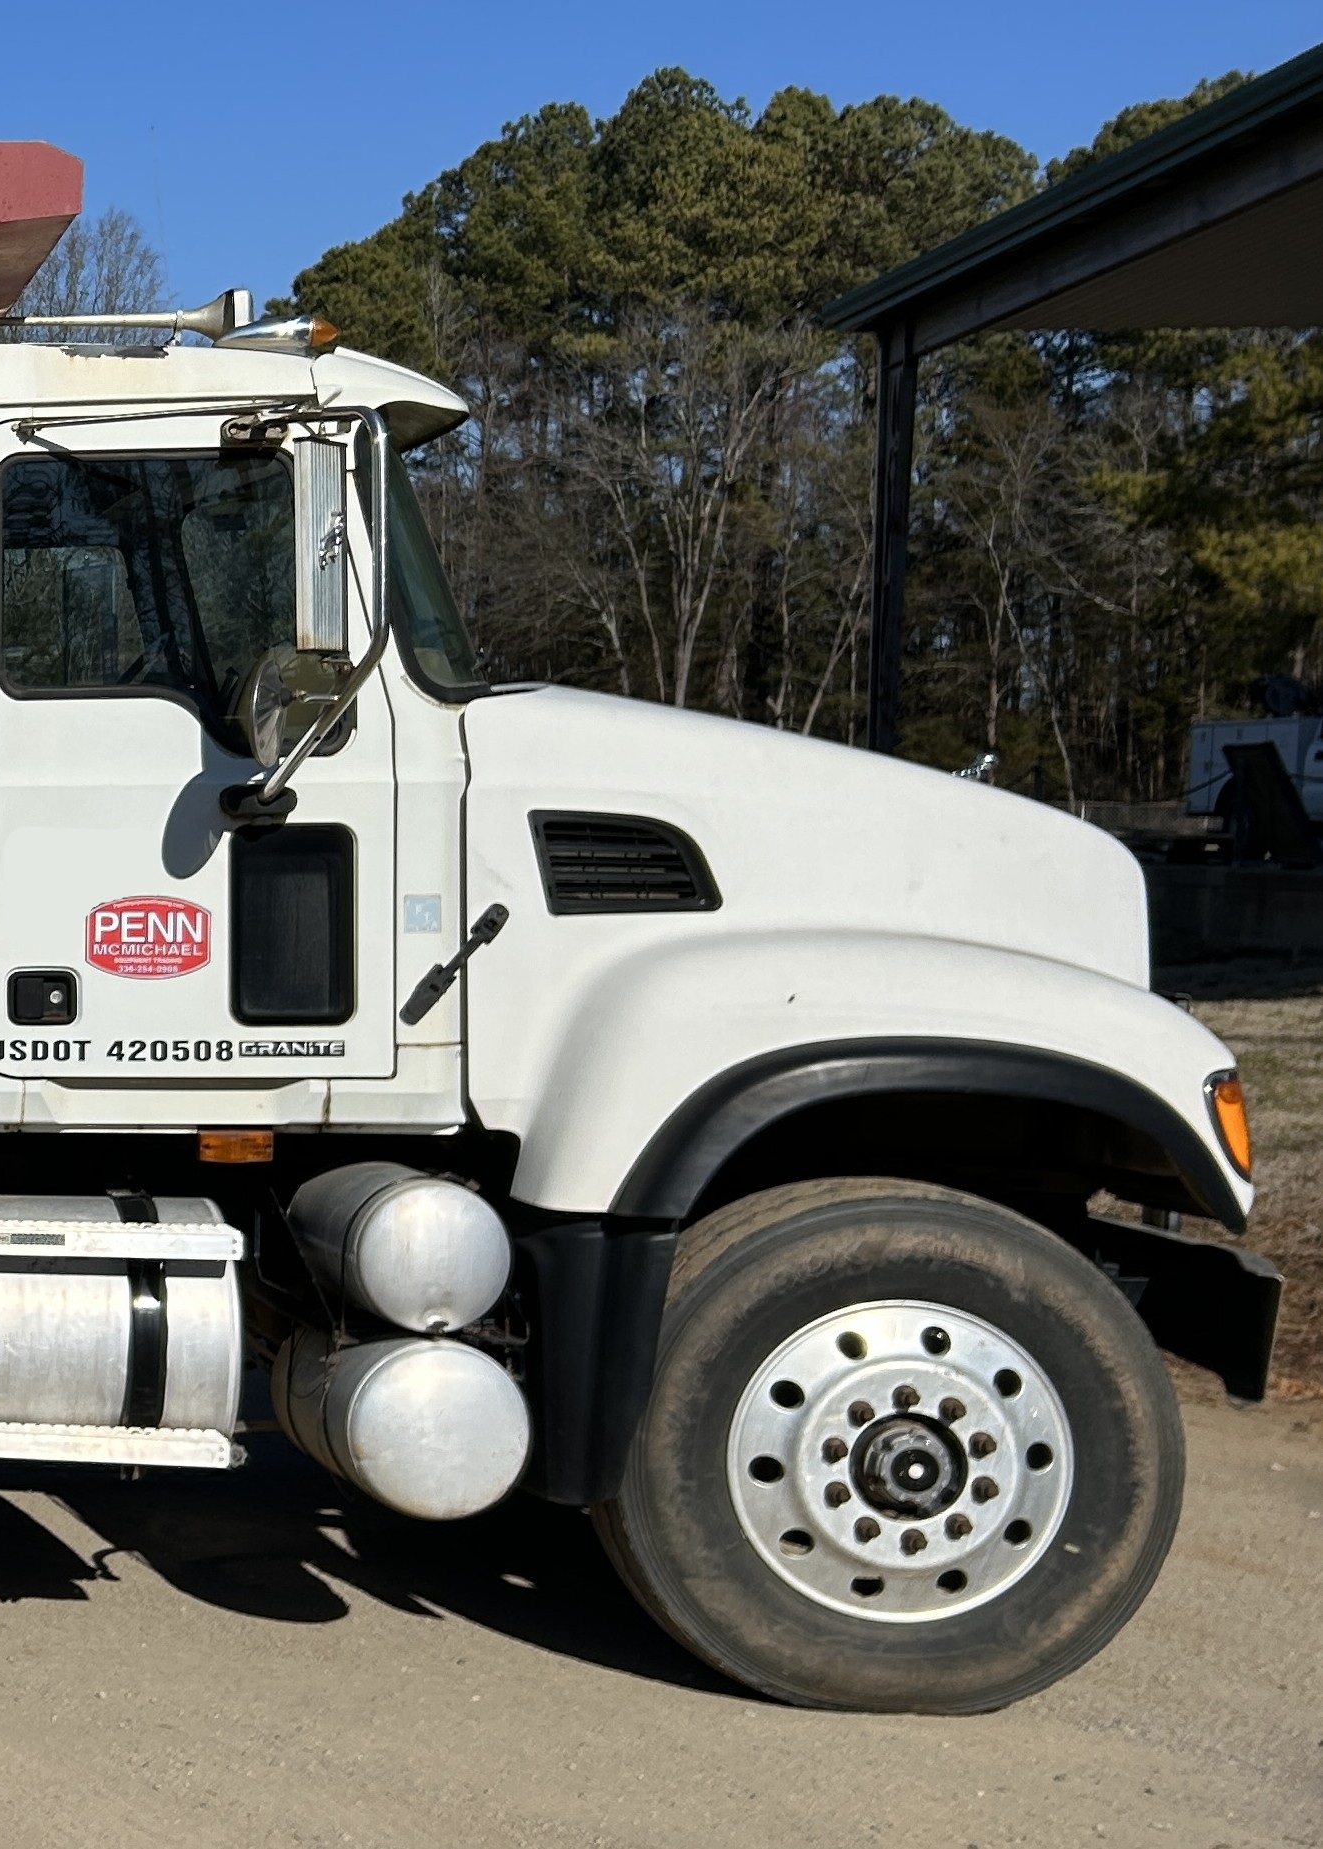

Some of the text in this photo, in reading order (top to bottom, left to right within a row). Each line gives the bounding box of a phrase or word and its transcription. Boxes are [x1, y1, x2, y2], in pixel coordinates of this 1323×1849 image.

[94, 911, 203, 943] PENN
[93, 943, 203, 957] MCMICHAEL
[106, 1039, 233, 1062] 420508
